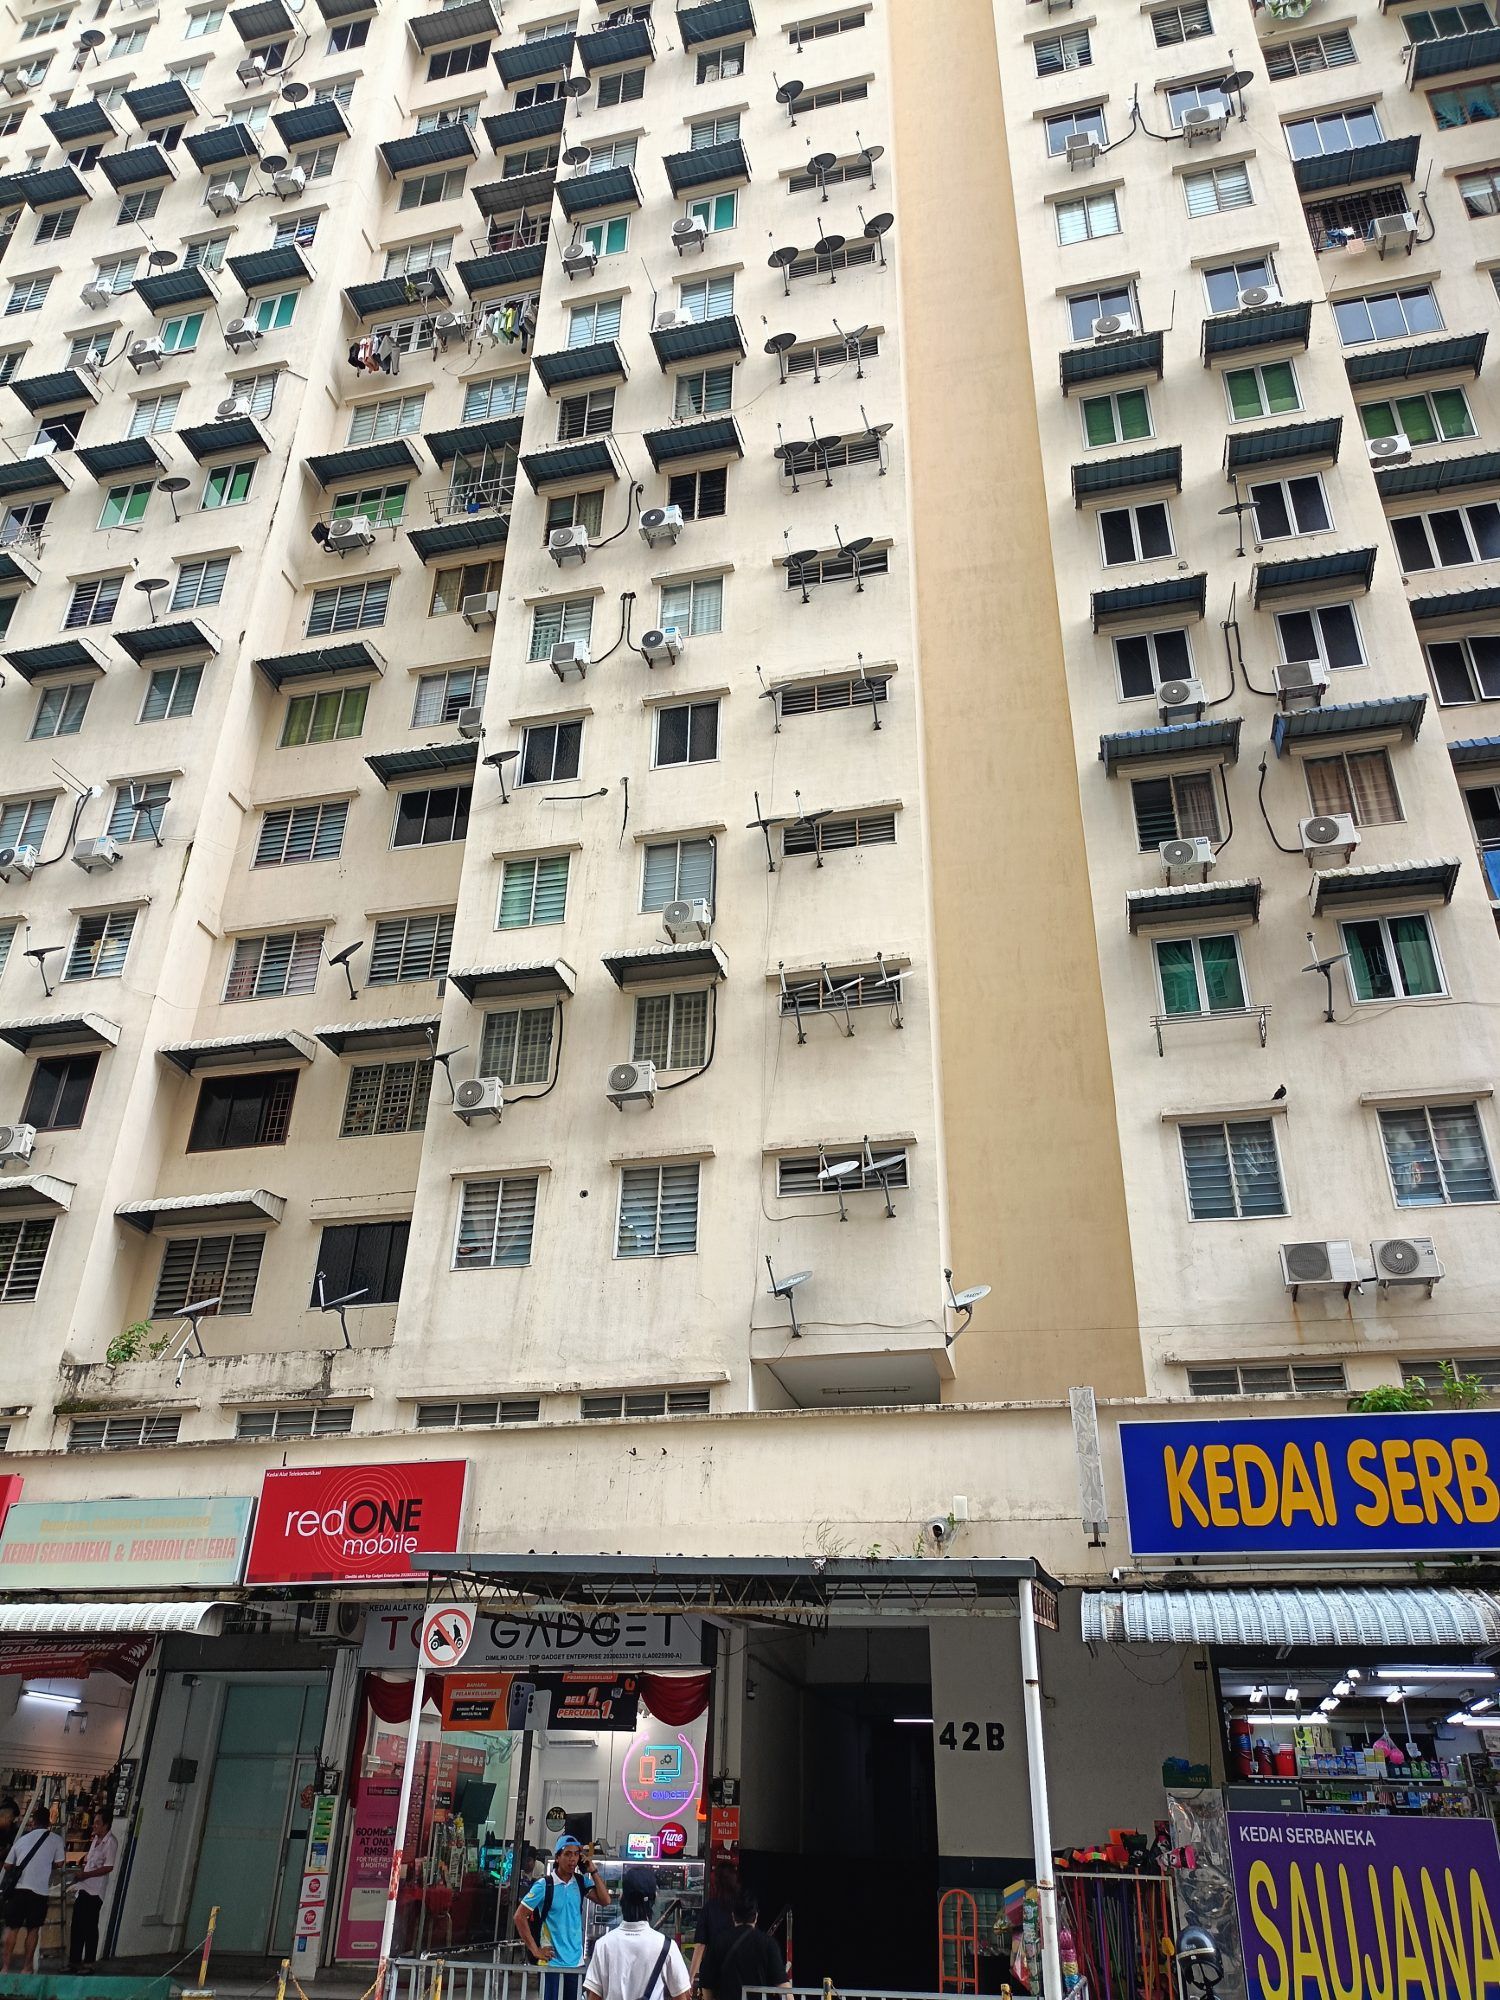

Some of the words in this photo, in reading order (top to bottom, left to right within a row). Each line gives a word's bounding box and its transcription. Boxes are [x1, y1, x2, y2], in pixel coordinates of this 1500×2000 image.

[1164, 1441, 1337, 1529] KEDAI
[1347, 1438, 1500, 1527] SERB
[284, 1499, 423, 1537] redONE
[1, 1543, 39, 1564] KEDAI
[39, 1541, 111, 1563] SERBANEKA
[114, 1543, 125, 1562] &
[128, 1539, 183, 1562] FASHION
[342, 1534, 418, 1556] mobile
[369, 1604, 392, 1612] KEDAI
[393, 1603, 412, 1612] ALAT
[413, 1603, 426, 1611] KO
[490, 1612, 682, 1649] GADGET
[22, 1644, 56, 1653] DATA
[58, 1642, 128, 1652] INTERNET
[564, 1695, 586, 1705] BELI
[557, 1708, 600, 1719] PERCUMA
[939, 1721, 1005, 1751] 42B
[630, 1789, 649, 1801] TOP
[651, 1789, 690, 1800] GADGET
[713, 1820, 737, 1828] Tambah
[360, 1838, 371, 1846] AT
[372, 1837, 395, 1846] ONLY
[661, 1829, 683, 1845] Tune
[1239, 1825, 1283, 1843] KEDAI
[1286, 1827, 1376, 1847] SERBANEKA
[363, 1847, 389, 1856] RM99
[1249, 1859, 1500, 2000] SAUJANA
